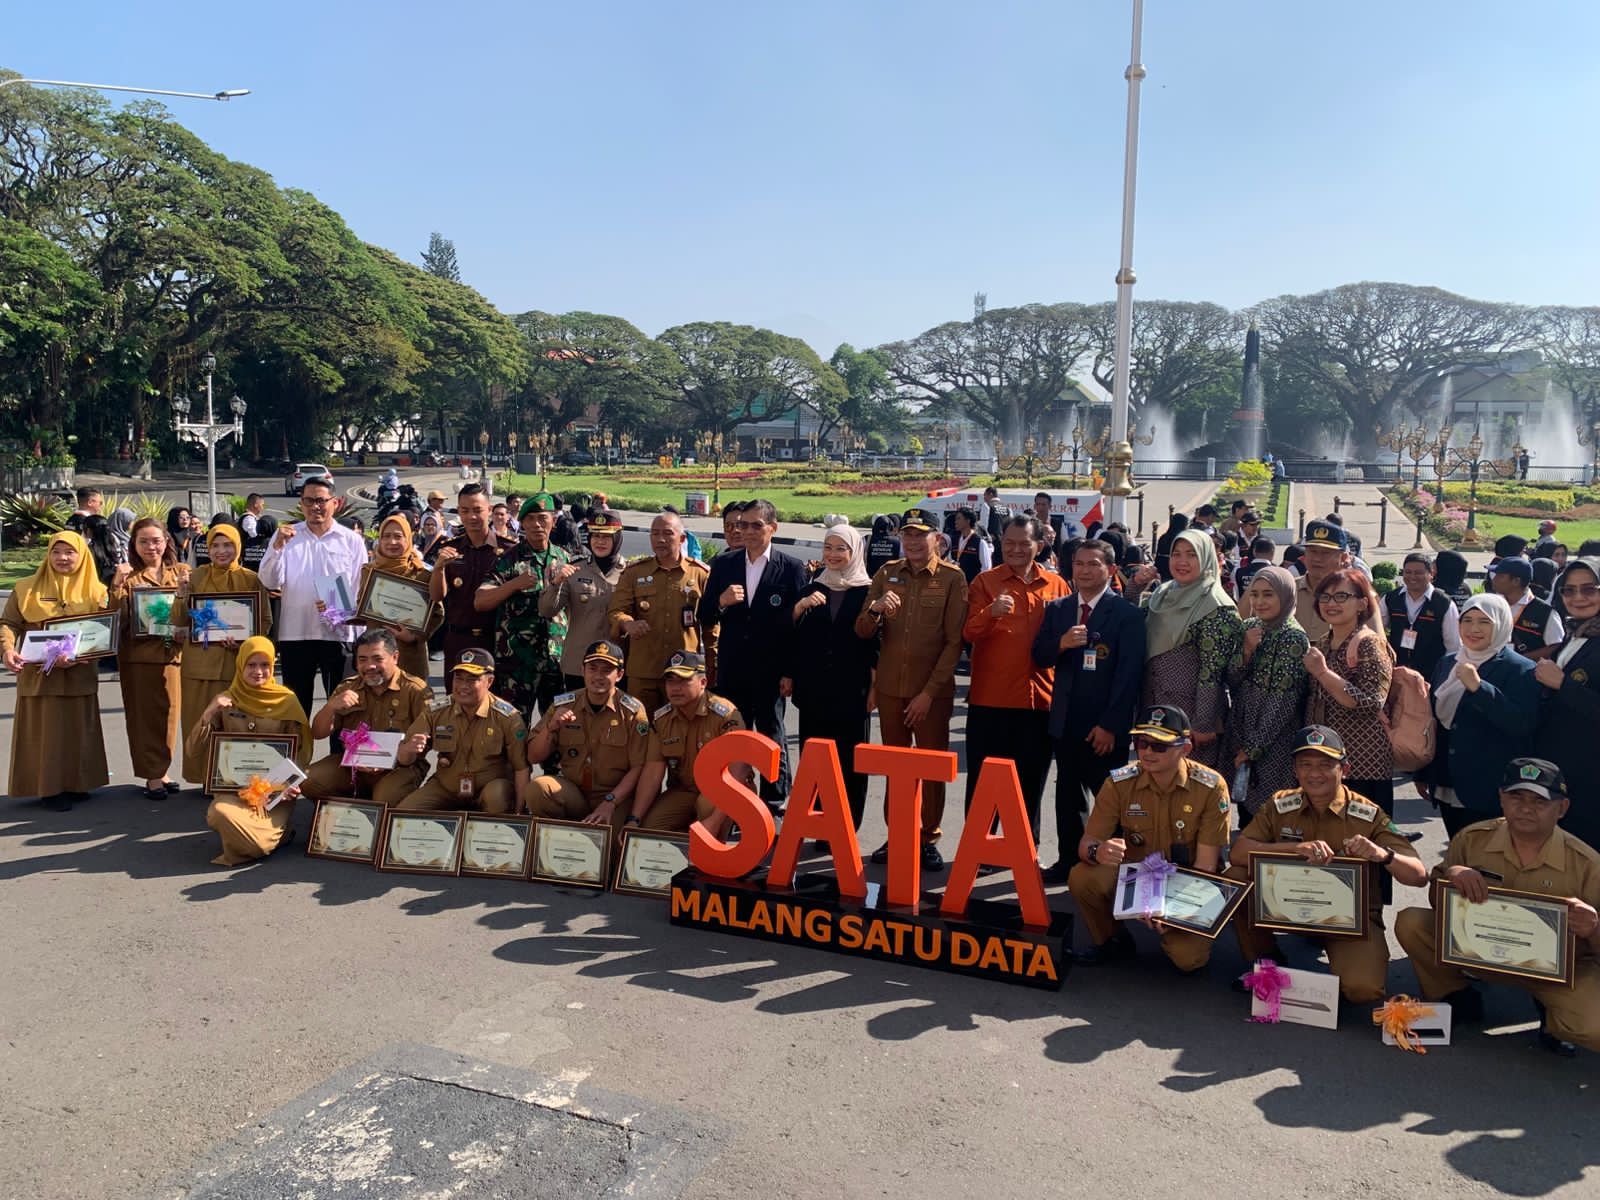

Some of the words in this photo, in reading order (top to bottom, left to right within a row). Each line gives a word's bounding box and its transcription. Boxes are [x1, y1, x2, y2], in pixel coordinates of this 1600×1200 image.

[688, 729, 1051, 928] SATA
[671, 886, 832, 943] MALANG
[838, 914, 942, 962] SATU
[950, 931, 1059, 981] DATA
